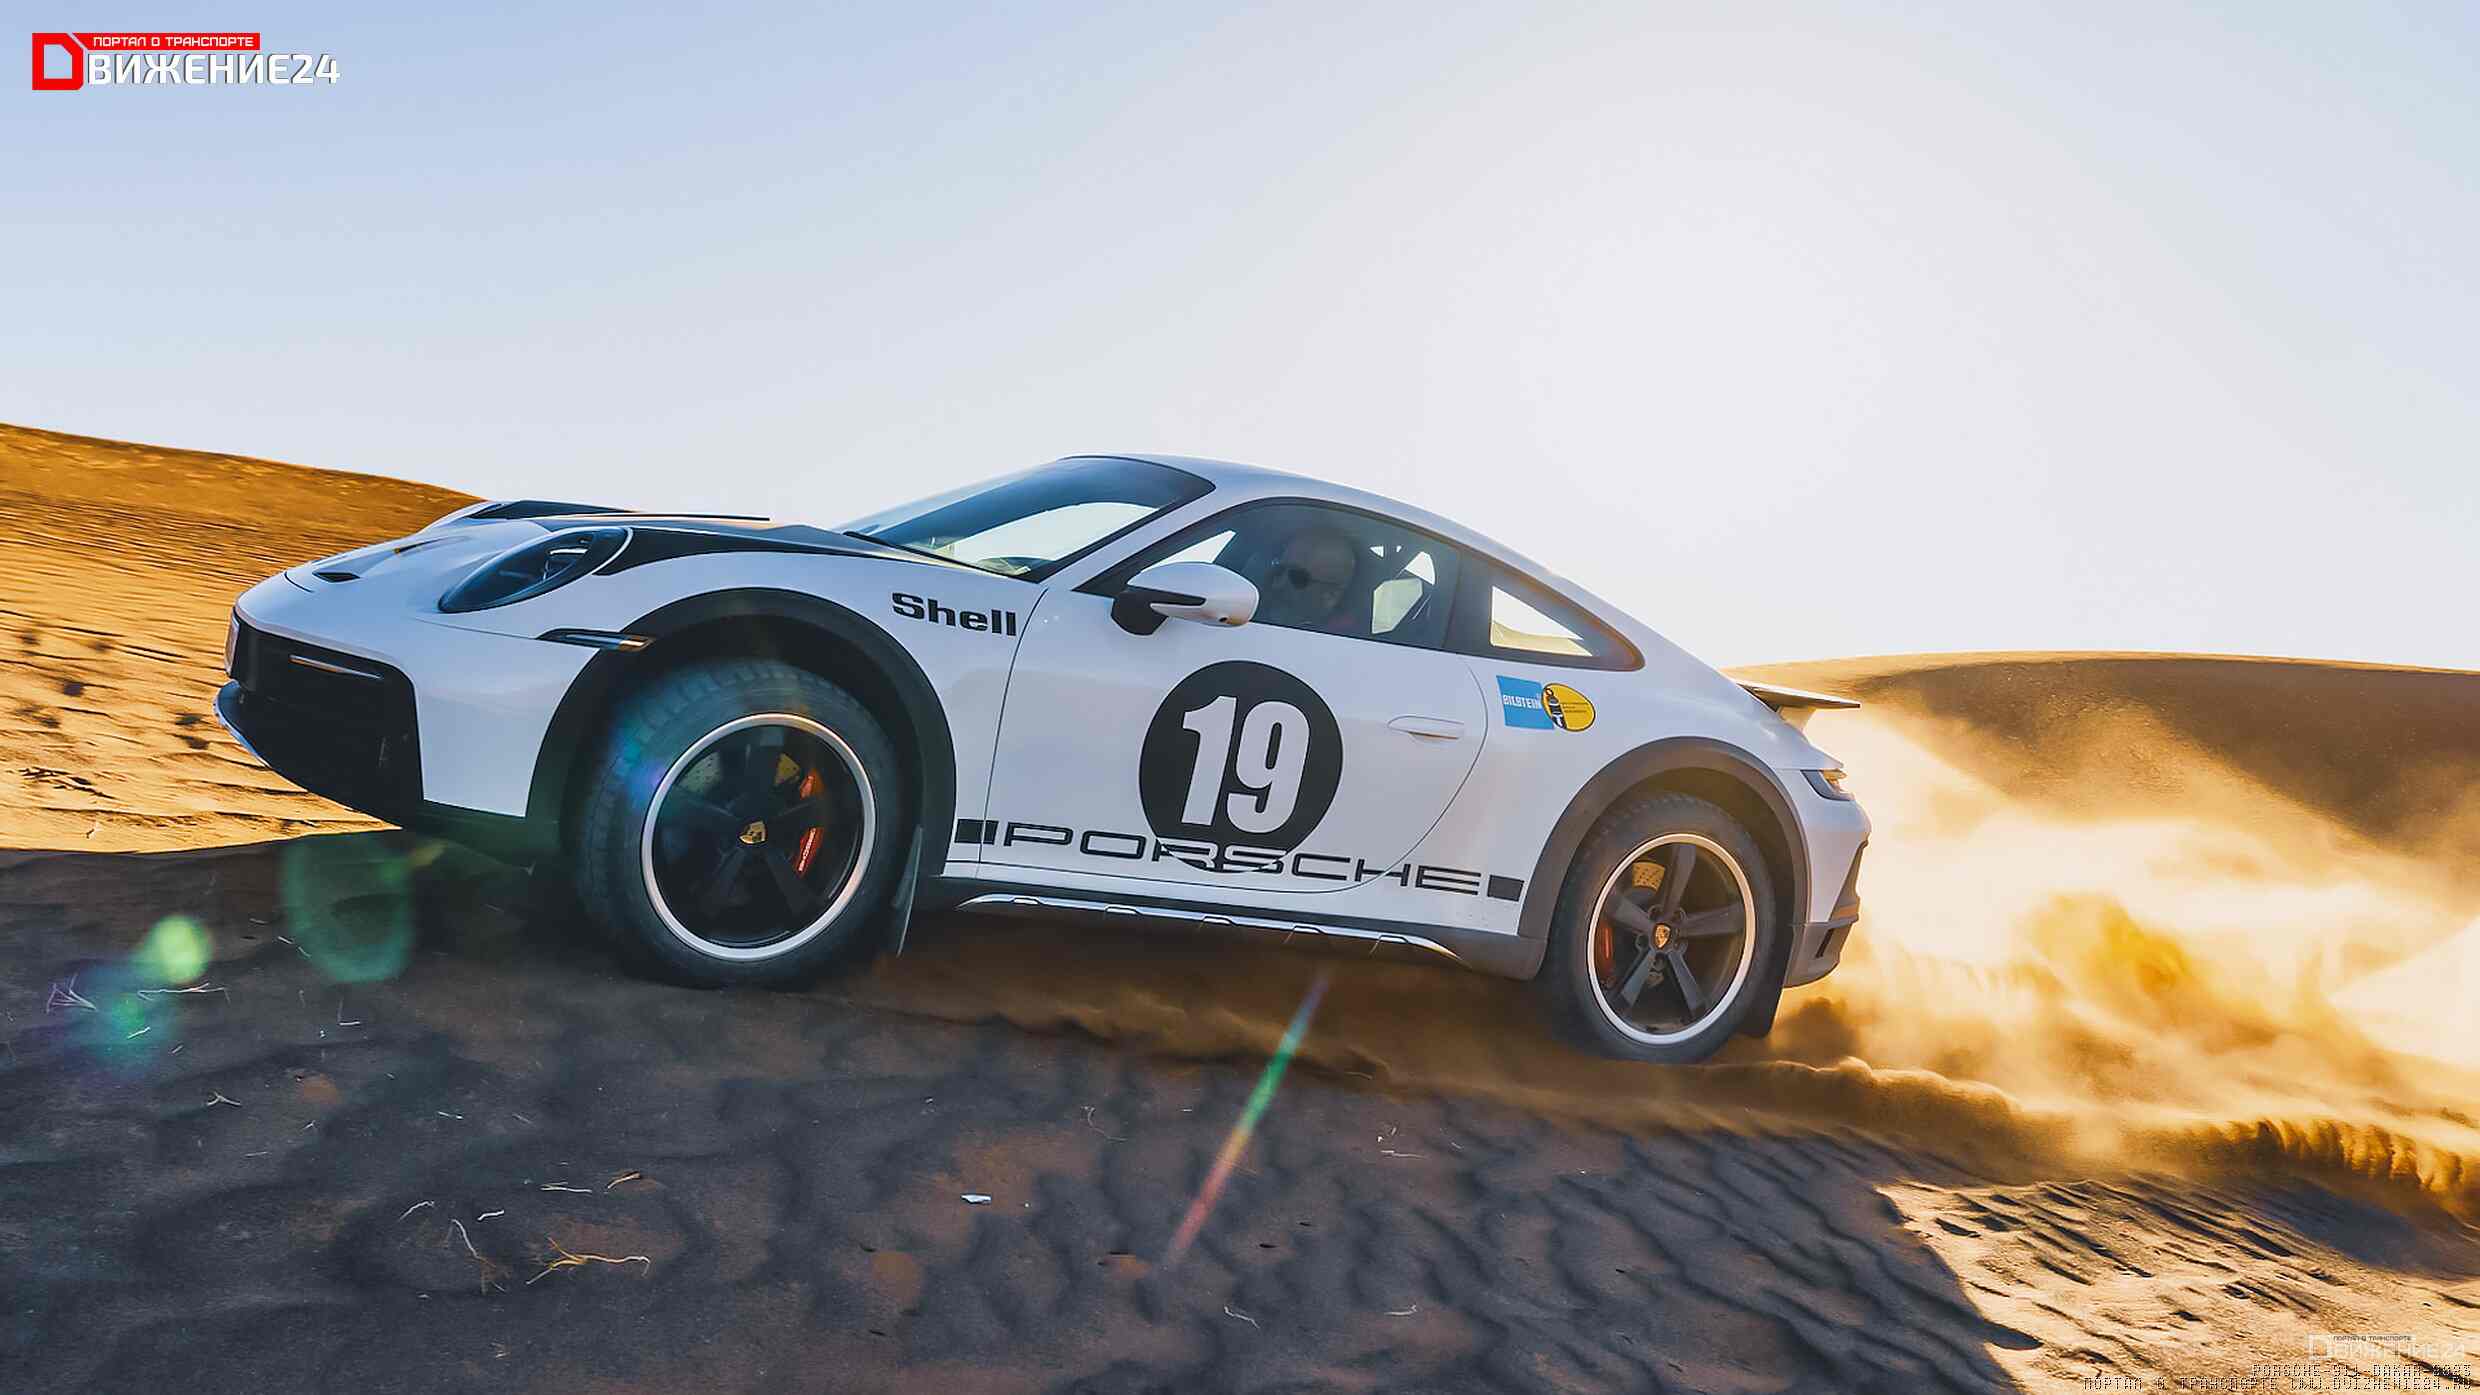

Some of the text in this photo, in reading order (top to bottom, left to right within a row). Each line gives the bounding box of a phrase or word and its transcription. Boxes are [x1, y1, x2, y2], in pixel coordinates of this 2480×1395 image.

[892, 592, 1017, 637] Shell
[1503, 694, 1543, 710] BILSTEIN
[1182, 695, 1311, 835] 19
[1003, 822, 1482, 895] PORSCHE
